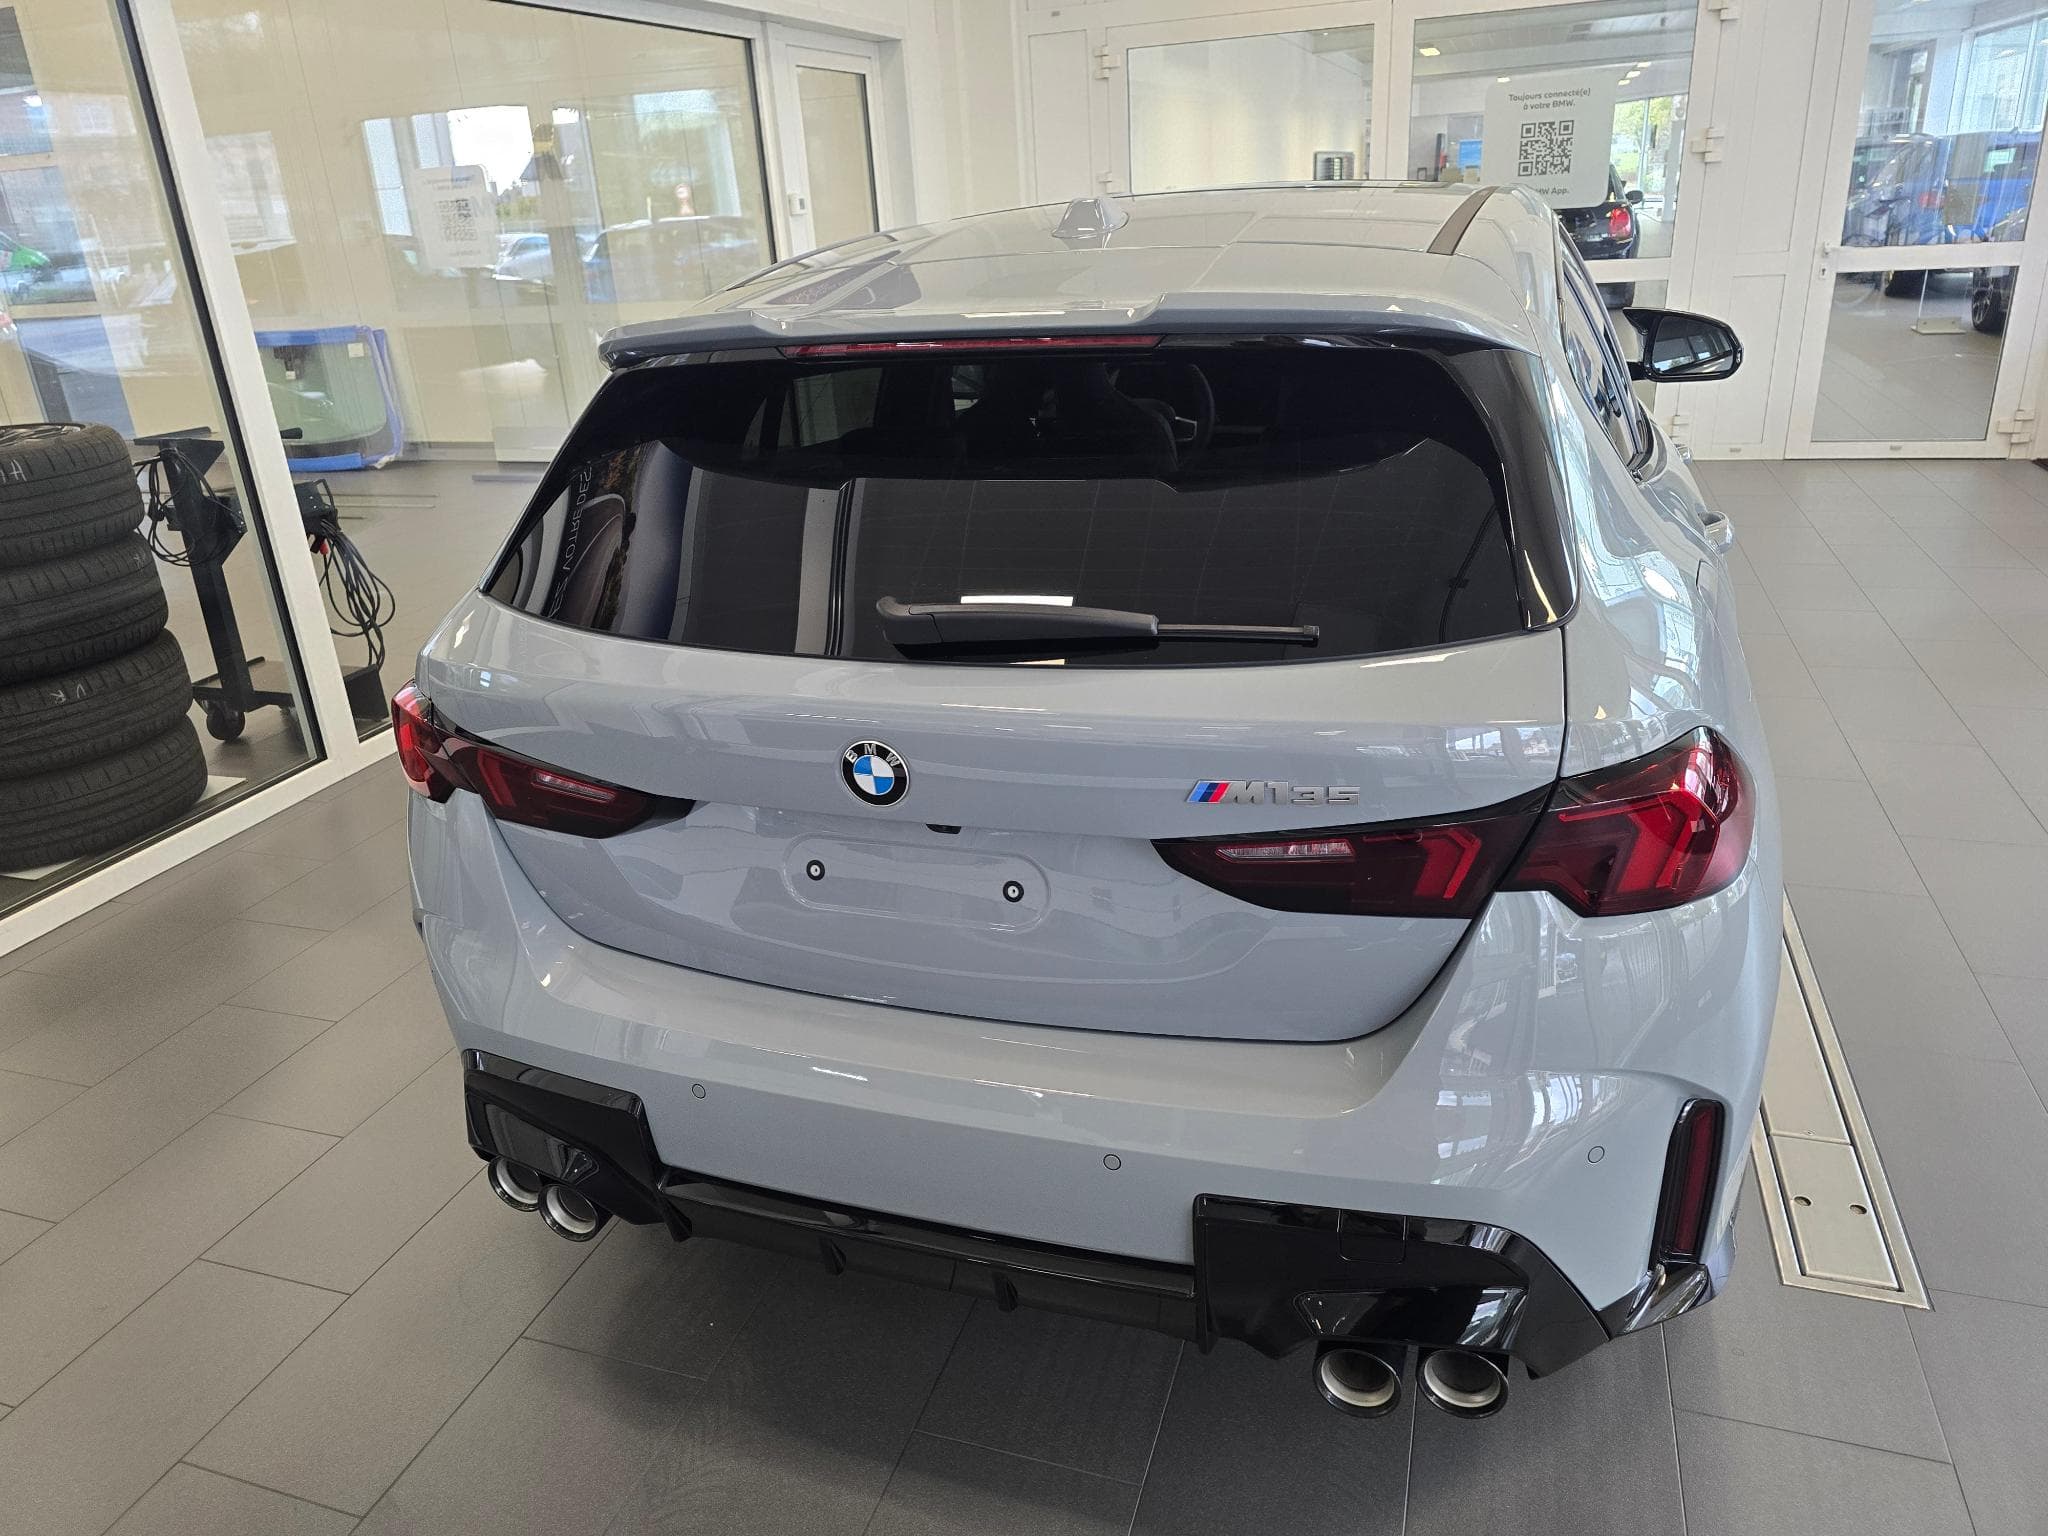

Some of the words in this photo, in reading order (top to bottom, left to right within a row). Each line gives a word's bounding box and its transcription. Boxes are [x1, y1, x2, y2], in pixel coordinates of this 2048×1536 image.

[1509, 93, 1542, 102] Toujours
[1544, 88, 1591, 99] connecté(e)
[1523, 103, 1529, 111] à
[1530, 102, 1551, 110] votre
[1552, 99, 1576, 108] BMW.
[1551, 187, 1570, 196] App.
[845, 743, 901, 767] BMW
[1221, 780, 1361, 806] M135
